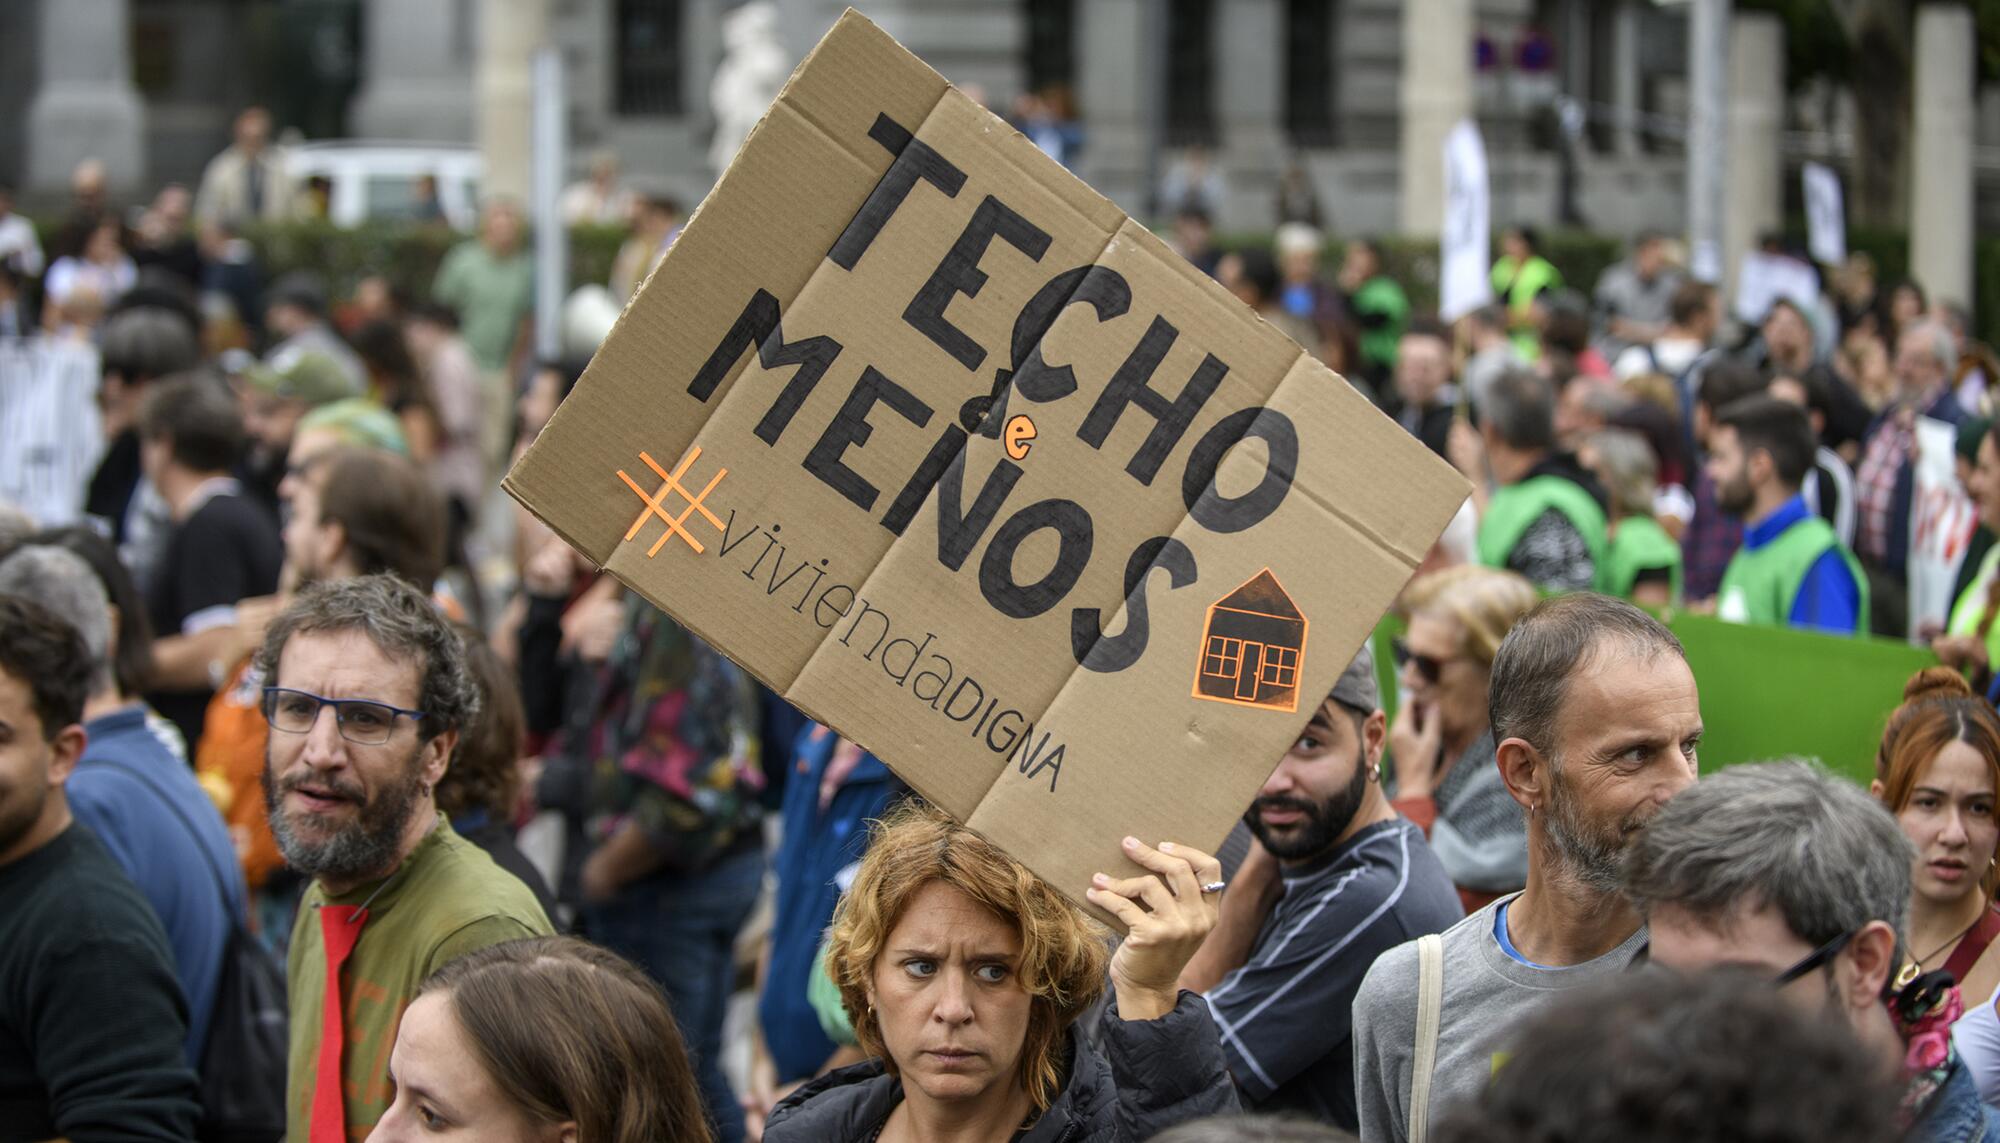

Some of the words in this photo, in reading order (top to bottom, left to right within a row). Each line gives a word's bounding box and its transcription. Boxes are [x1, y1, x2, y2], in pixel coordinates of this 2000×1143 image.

[686, 287, 1198, 673] MENOS
[827, 112, 1300, 533] TECHO
[959, 367, 1038, 461] de
